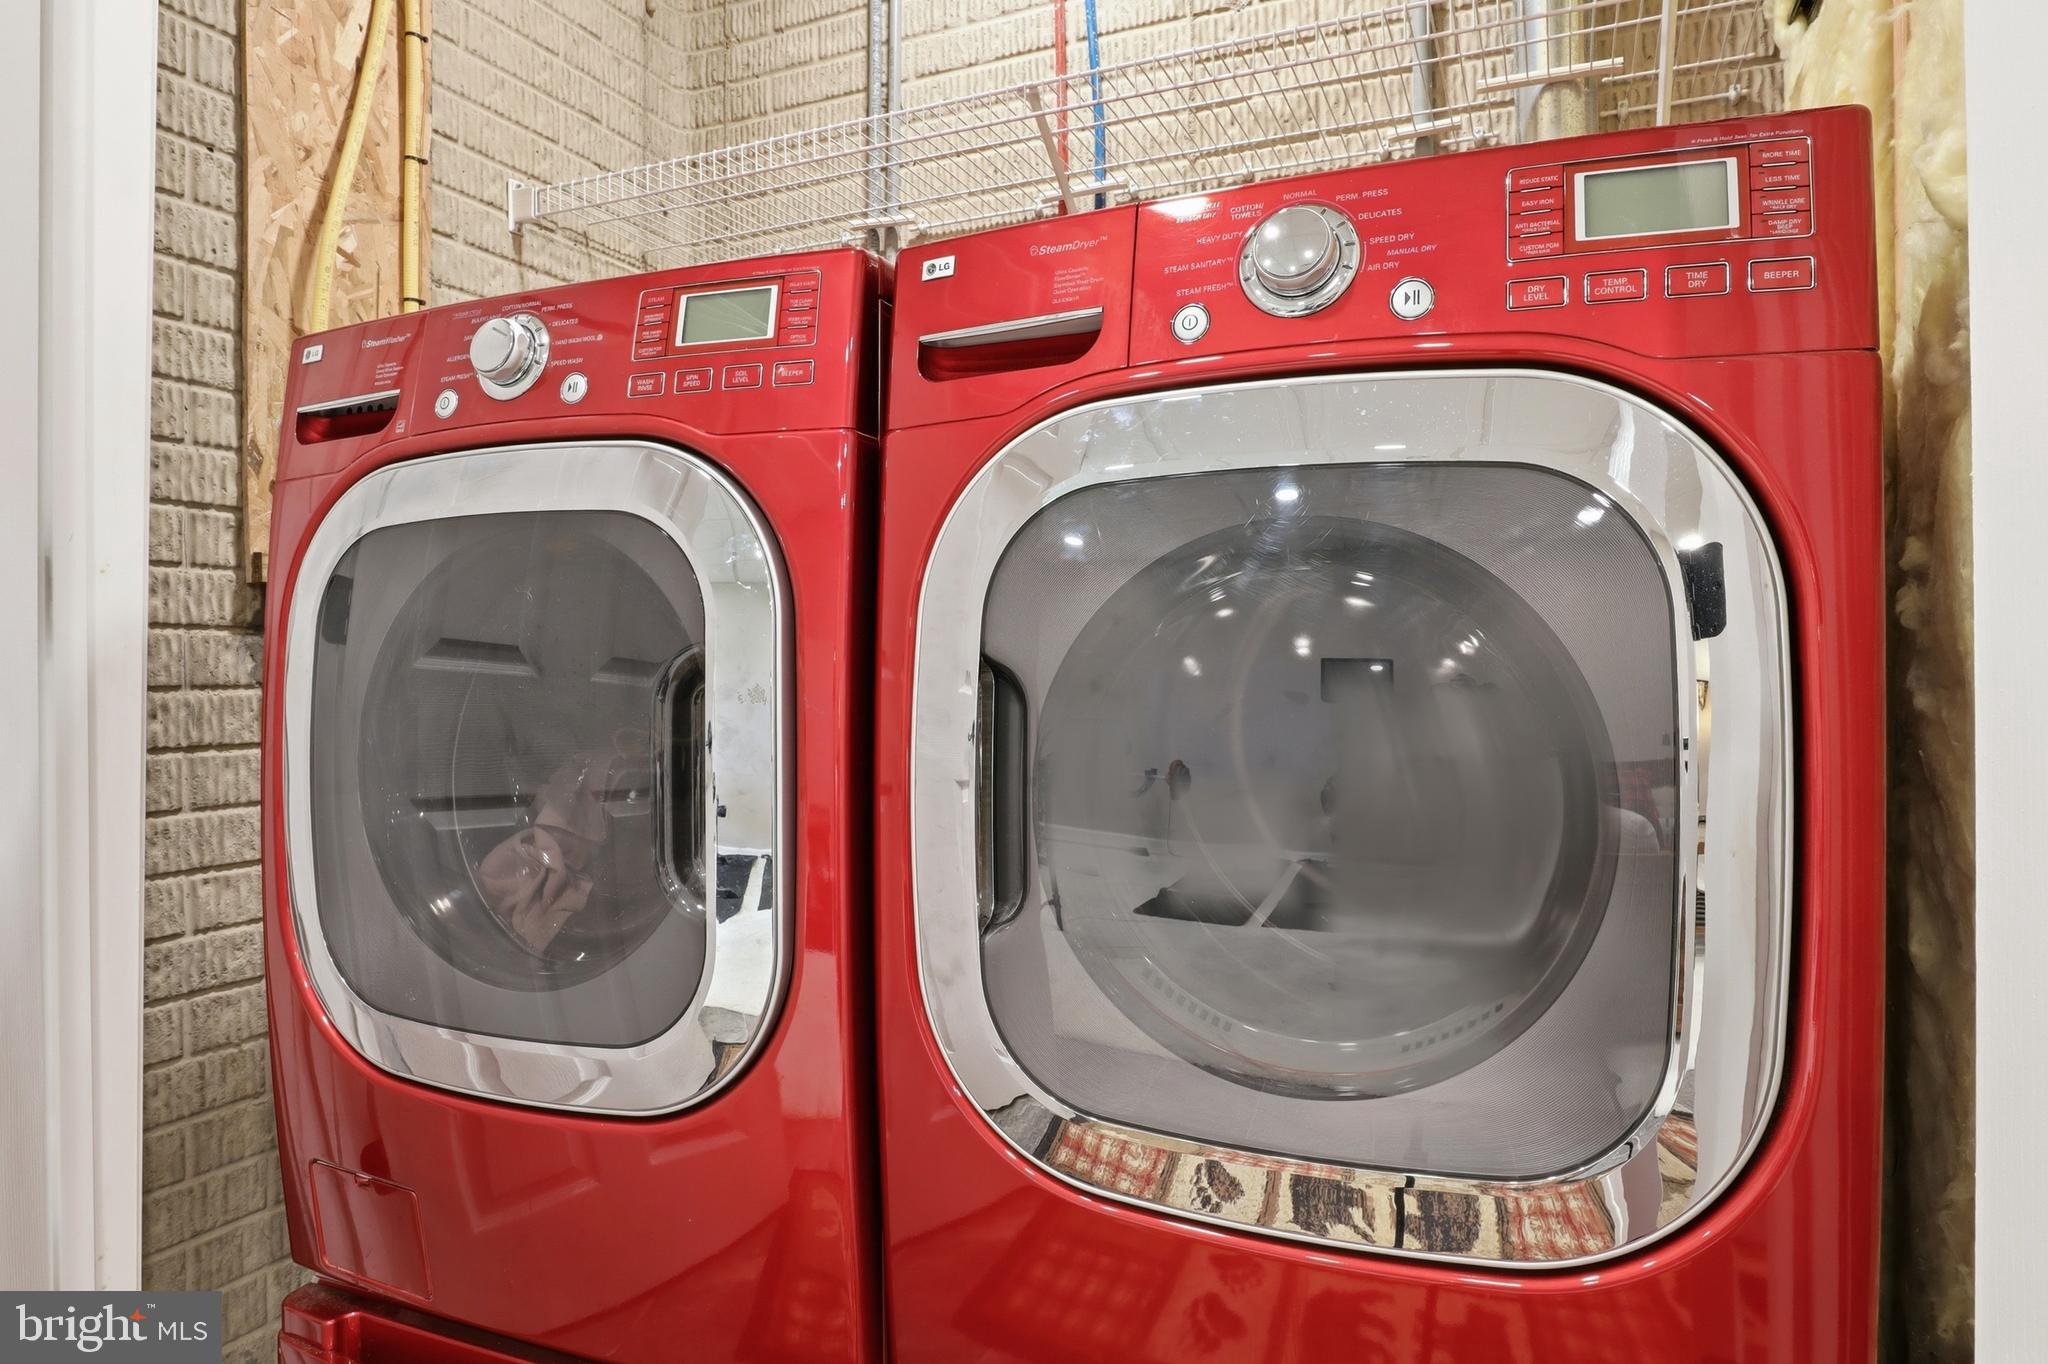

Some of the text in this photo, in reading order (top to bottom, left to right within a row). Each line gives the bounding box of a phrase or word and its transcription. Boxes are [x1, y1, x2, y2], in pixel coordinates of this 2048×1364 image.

[1762, 149, 1801, 159] MORE TIME
[1520, 177, 1540, 185] REDUCE
[1283, 189, 1317, 200] NORMAL
[1335, 188, 1388, 202] PERM. PRESS
[1201, 211, 1217, 220] DRY
[1231, 210, 1263, 221] TOWELS
[1358, 208, 1403, 221] DELICATES
[1530, 219, 1560, 229] BACTERIAL
[1196, 231, 1243, 245] HEAVY DUTY
[1369, 233, 1415, 245] SPEED DRY
[1387, 244, 1438, 256] MANUAL DRY
[1519, 244, 1545, 252] CUSTOM
[938, 262, 951, 272] LG
[1164, 264, 1190, 274] STEAM
[1367, 261, 1400, 272] AIR DRY
[1686, 270, 1709, 280] TIME
[1764, 269, 1800, 280] BEEPER
[1688, 278, 1707, 288] DRY
[1176, 287, 1203, 297] STEAM
[1528, 284, 1546, 293] DRY
[1594, 284, 1638, 295] CONTROL
[1523, 291, 1550, 301] LEVEL
[552, 317, 579, 327] DELICATES
[550, 359, 567, 368] SPEED
[683, 380, 701, 388] SPEED
